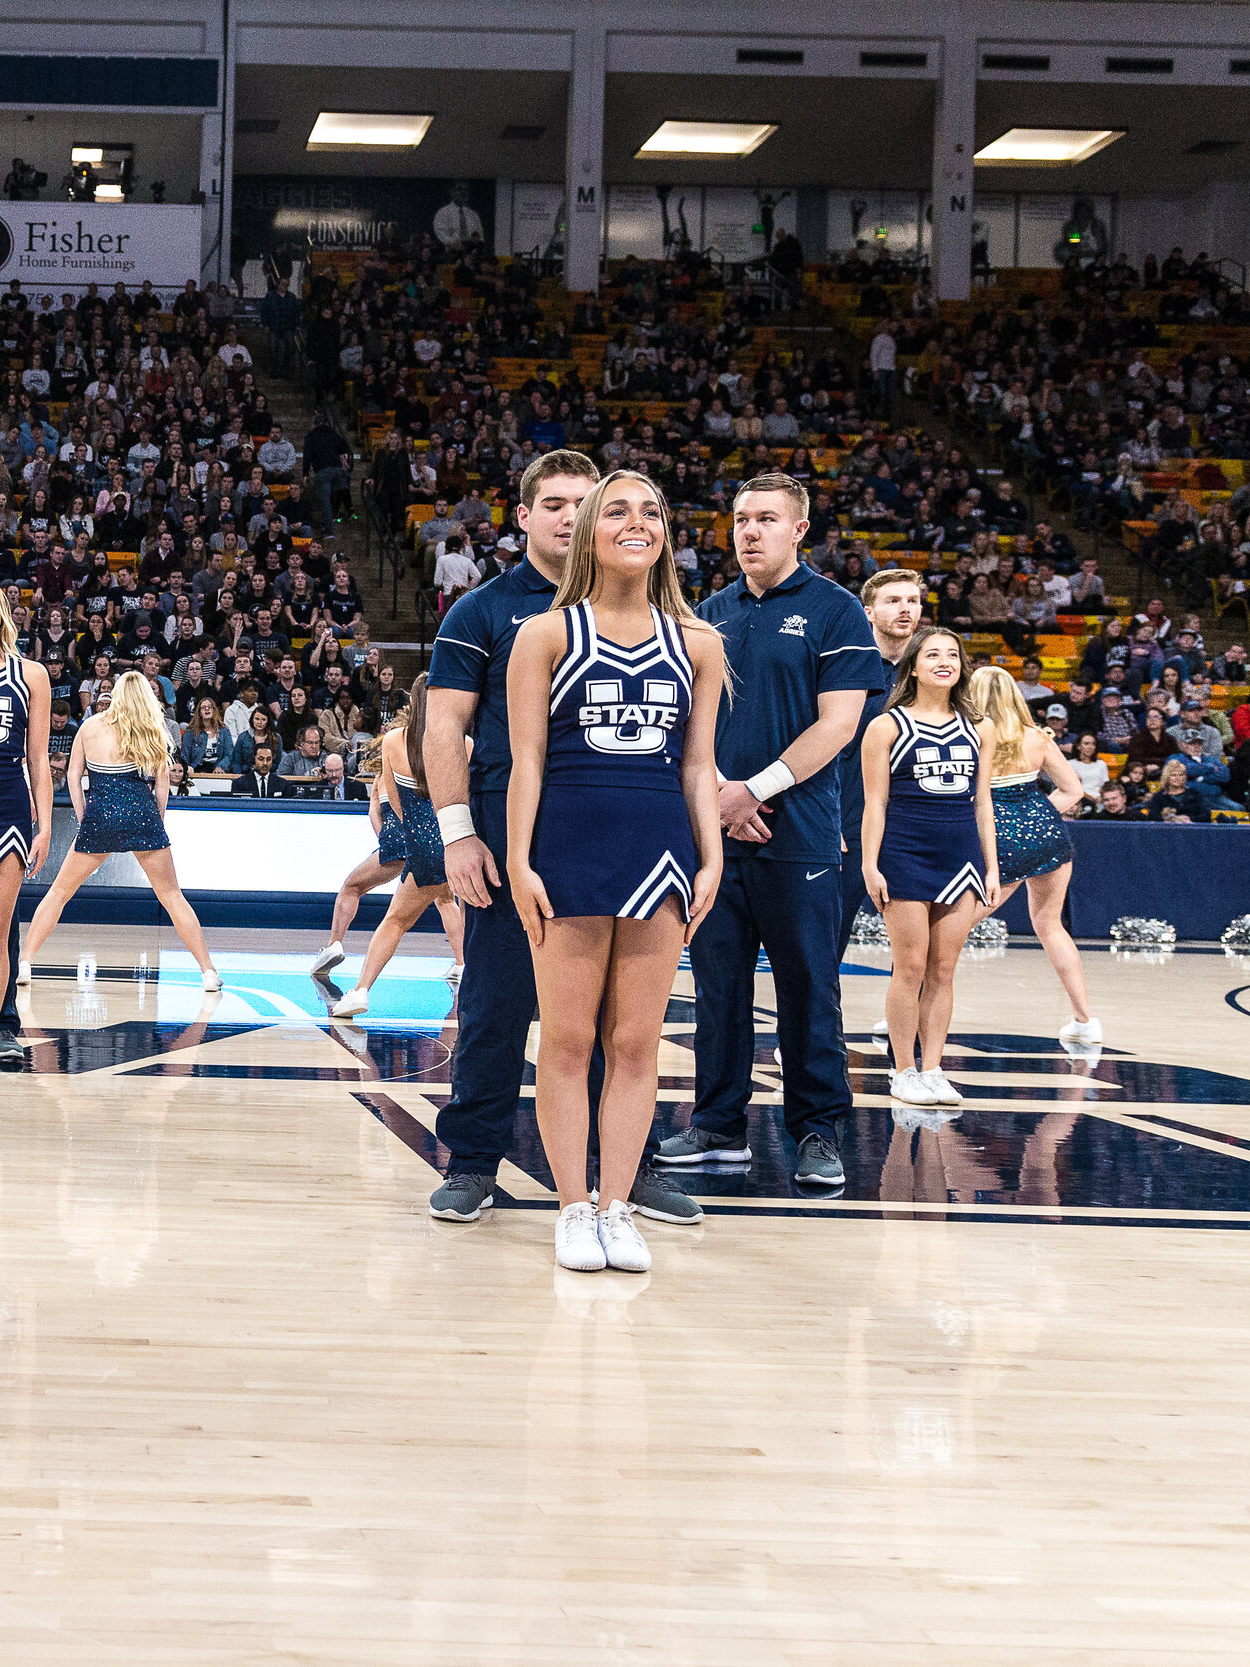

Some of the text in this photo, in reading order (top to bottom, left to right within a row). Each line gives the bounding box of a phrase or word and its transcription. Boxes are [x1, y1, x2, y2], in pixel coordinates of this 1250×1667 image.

[211, 178, 221, 195] L
[578, 186, 595, 203] M
[951, 195, 965, 212] N
[24, 220, 130, 254] Fisher
[307, 219, 397, 245] CONSERVIC
[19, 255, 135, 272] Home Furnishings
[578, 704, 679, 730] STATE
[913, 761, 975, 779] STATE
